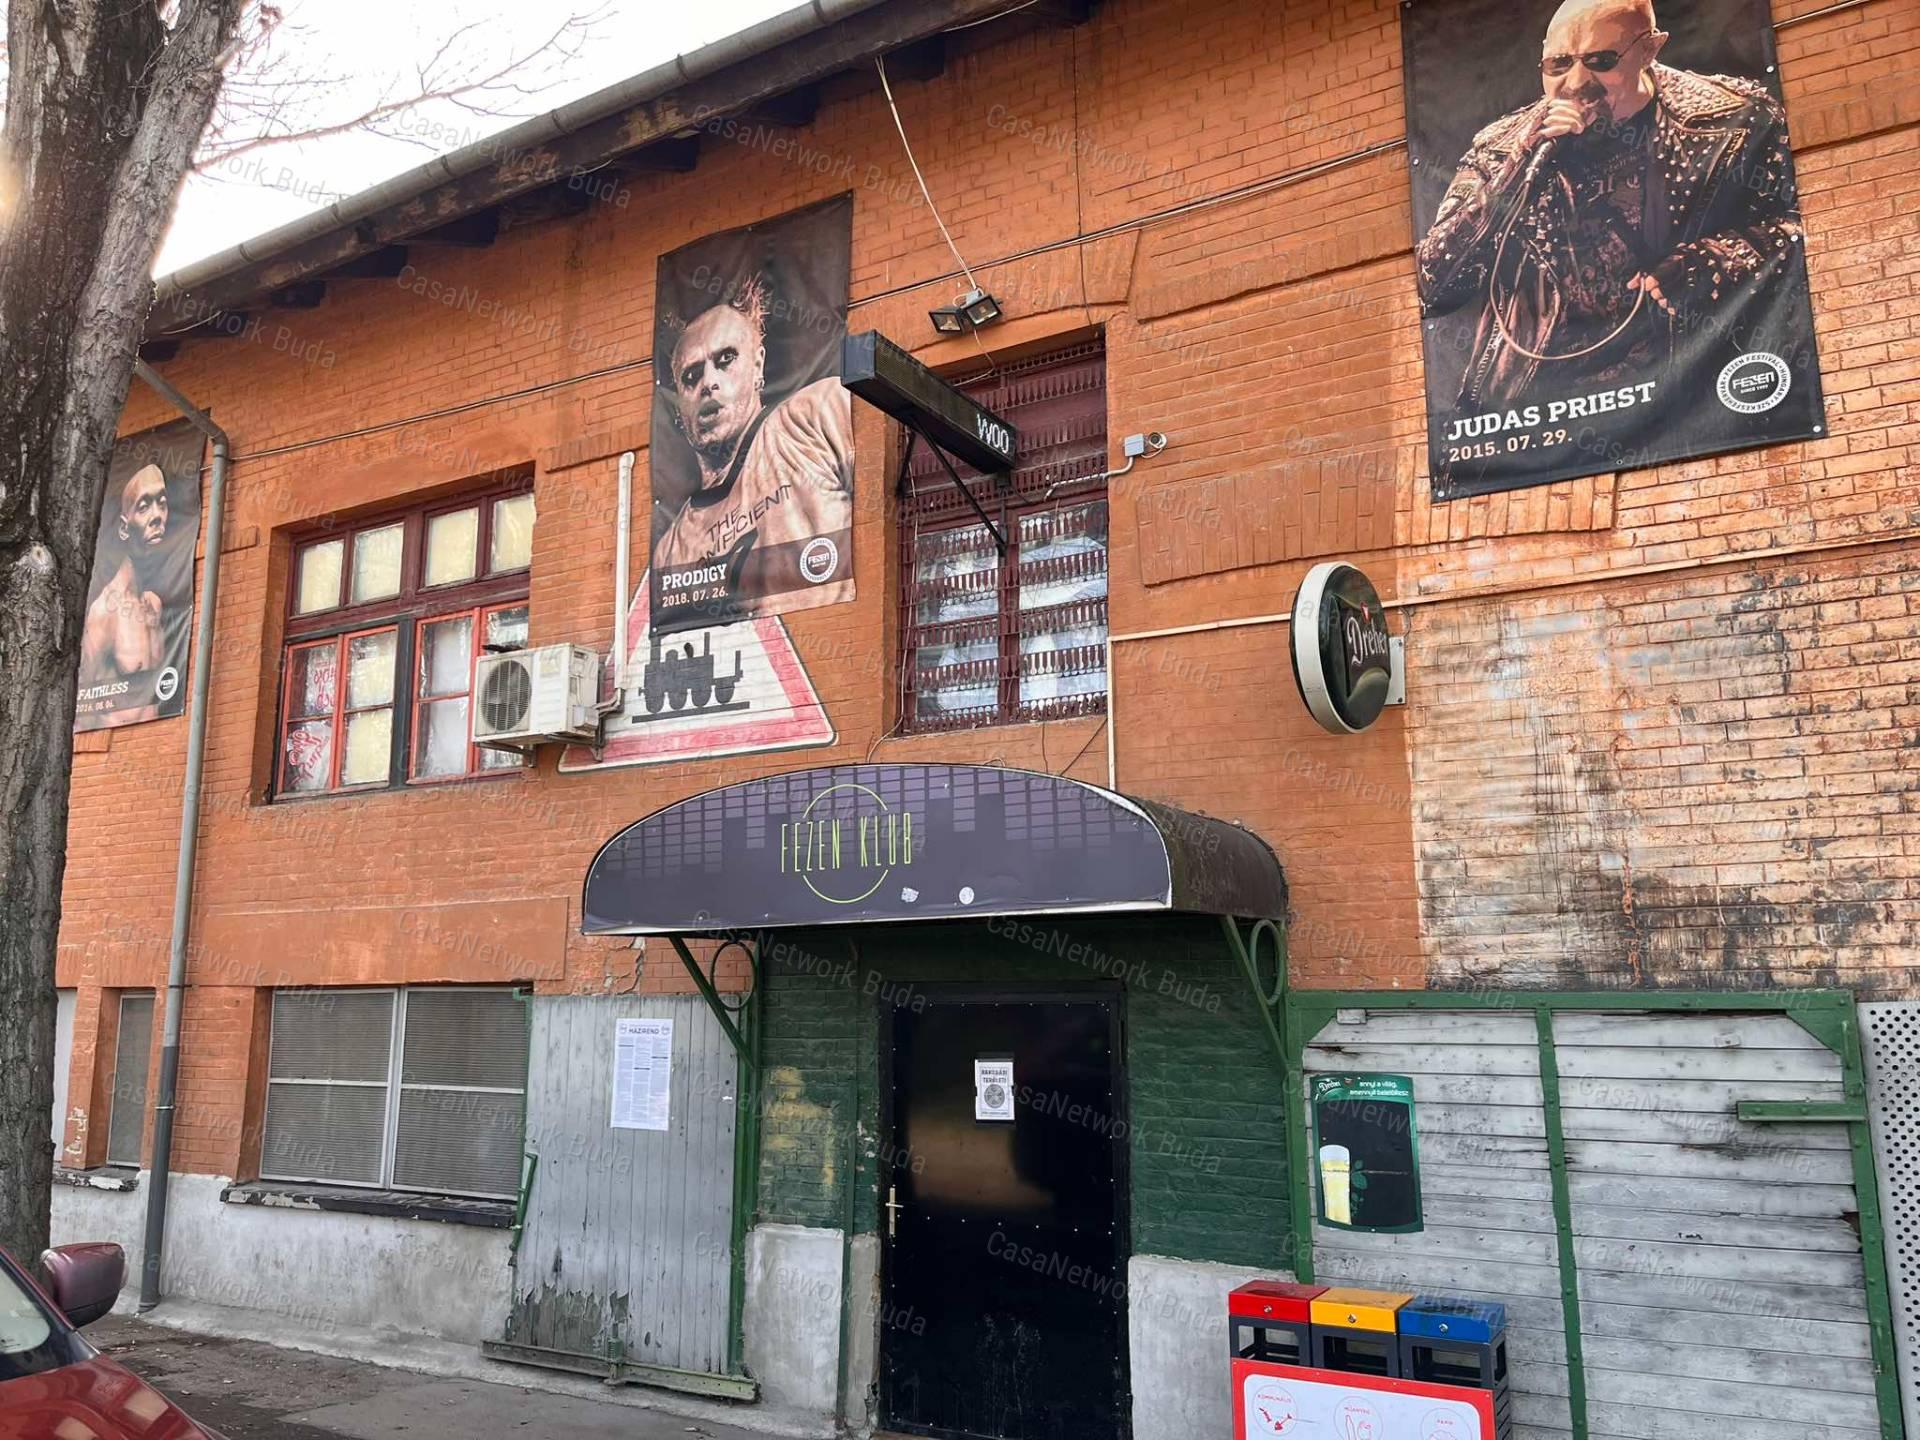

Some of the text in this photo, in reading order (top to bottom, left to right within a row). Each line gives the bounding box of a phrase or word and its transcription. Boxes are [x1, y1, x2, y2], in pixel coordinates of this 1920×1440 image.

[1448, 381, 1656, 441] JUDAS PRIEST
[1449, 429, 1573, 463] 2015. 07. 29.
[708, 507, 742, 542] THE
[662, 563, 728, 591] PRODIGY
[662, 585, 729, 608] 2018. 07. 26.
[77, 681, 129, 701] FAITHLESS
[781, 812, 912, 873] FEZEN KLUB
